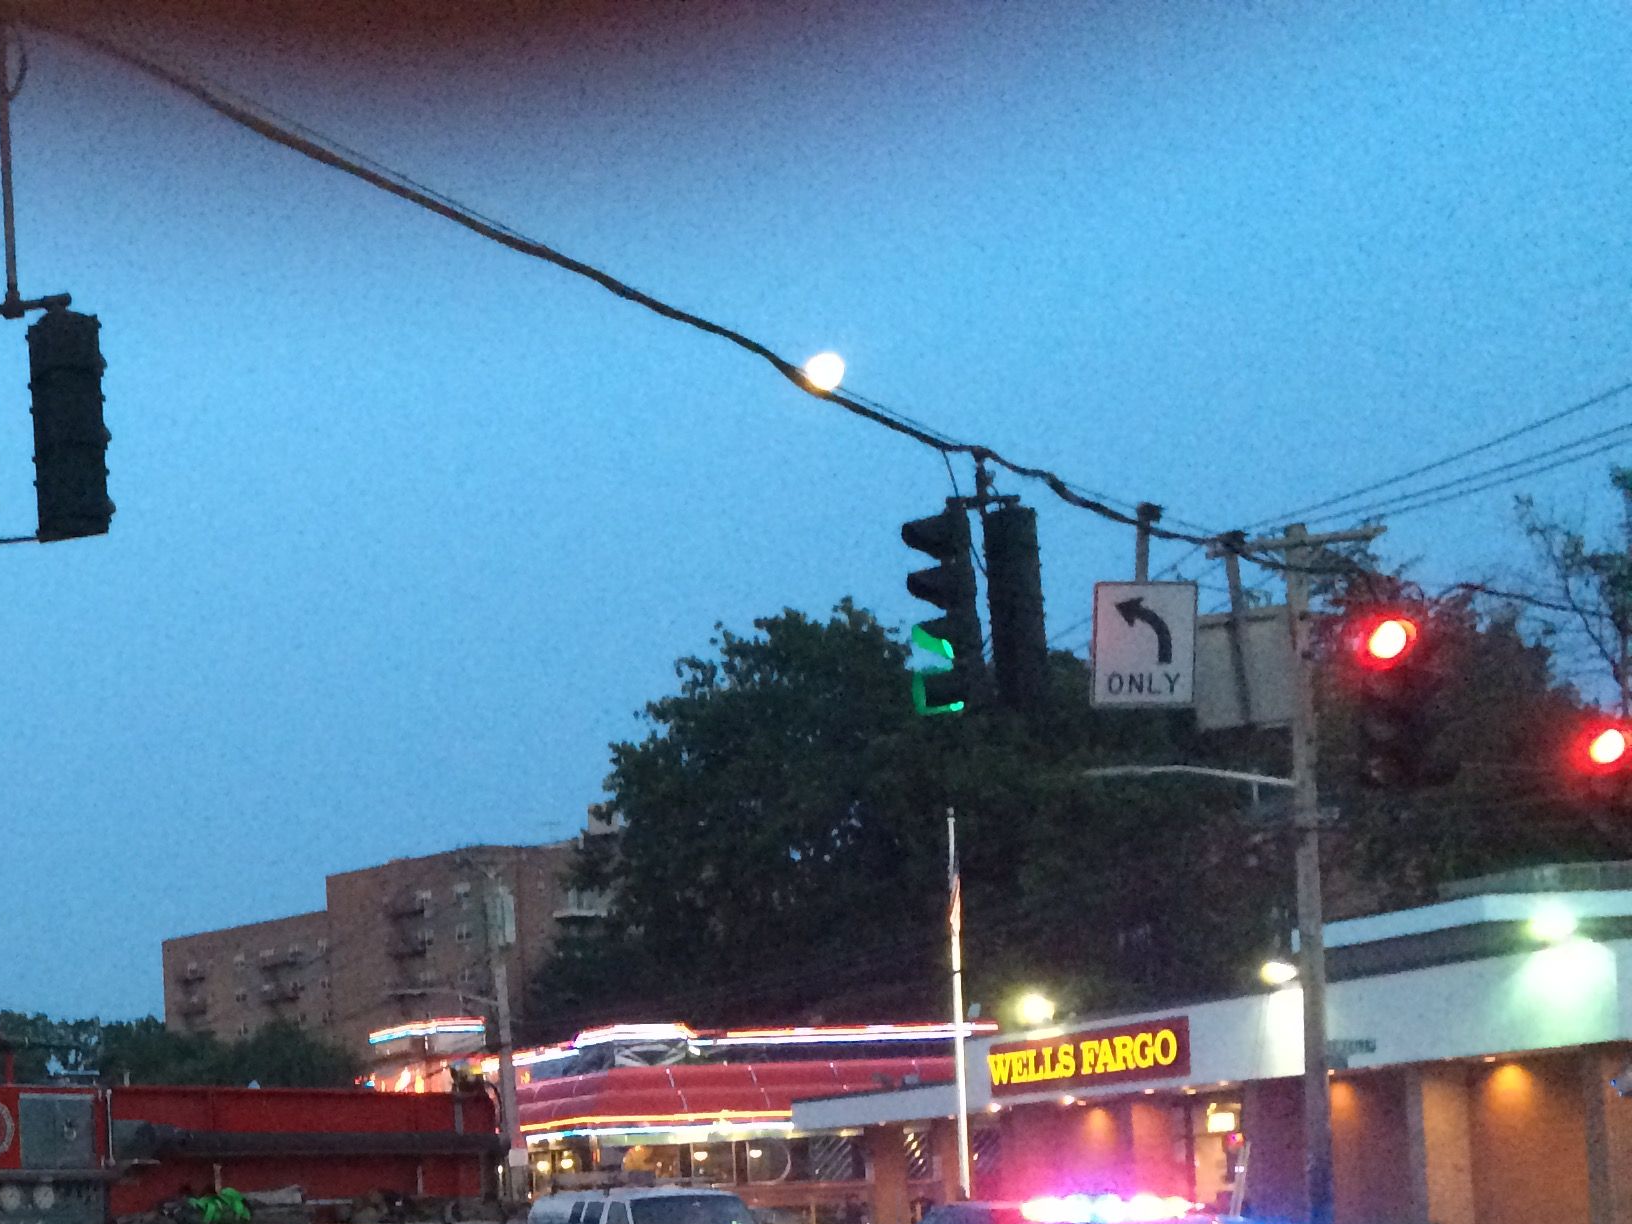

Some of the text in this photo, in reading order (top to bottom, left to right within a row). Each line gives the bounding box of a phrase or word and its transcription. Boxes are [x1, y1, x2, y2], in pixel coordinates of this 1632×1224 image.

[1109, 670, 1180, 695] ONLY
[987, 1029, 1177, 1086] WELLS FARGO
